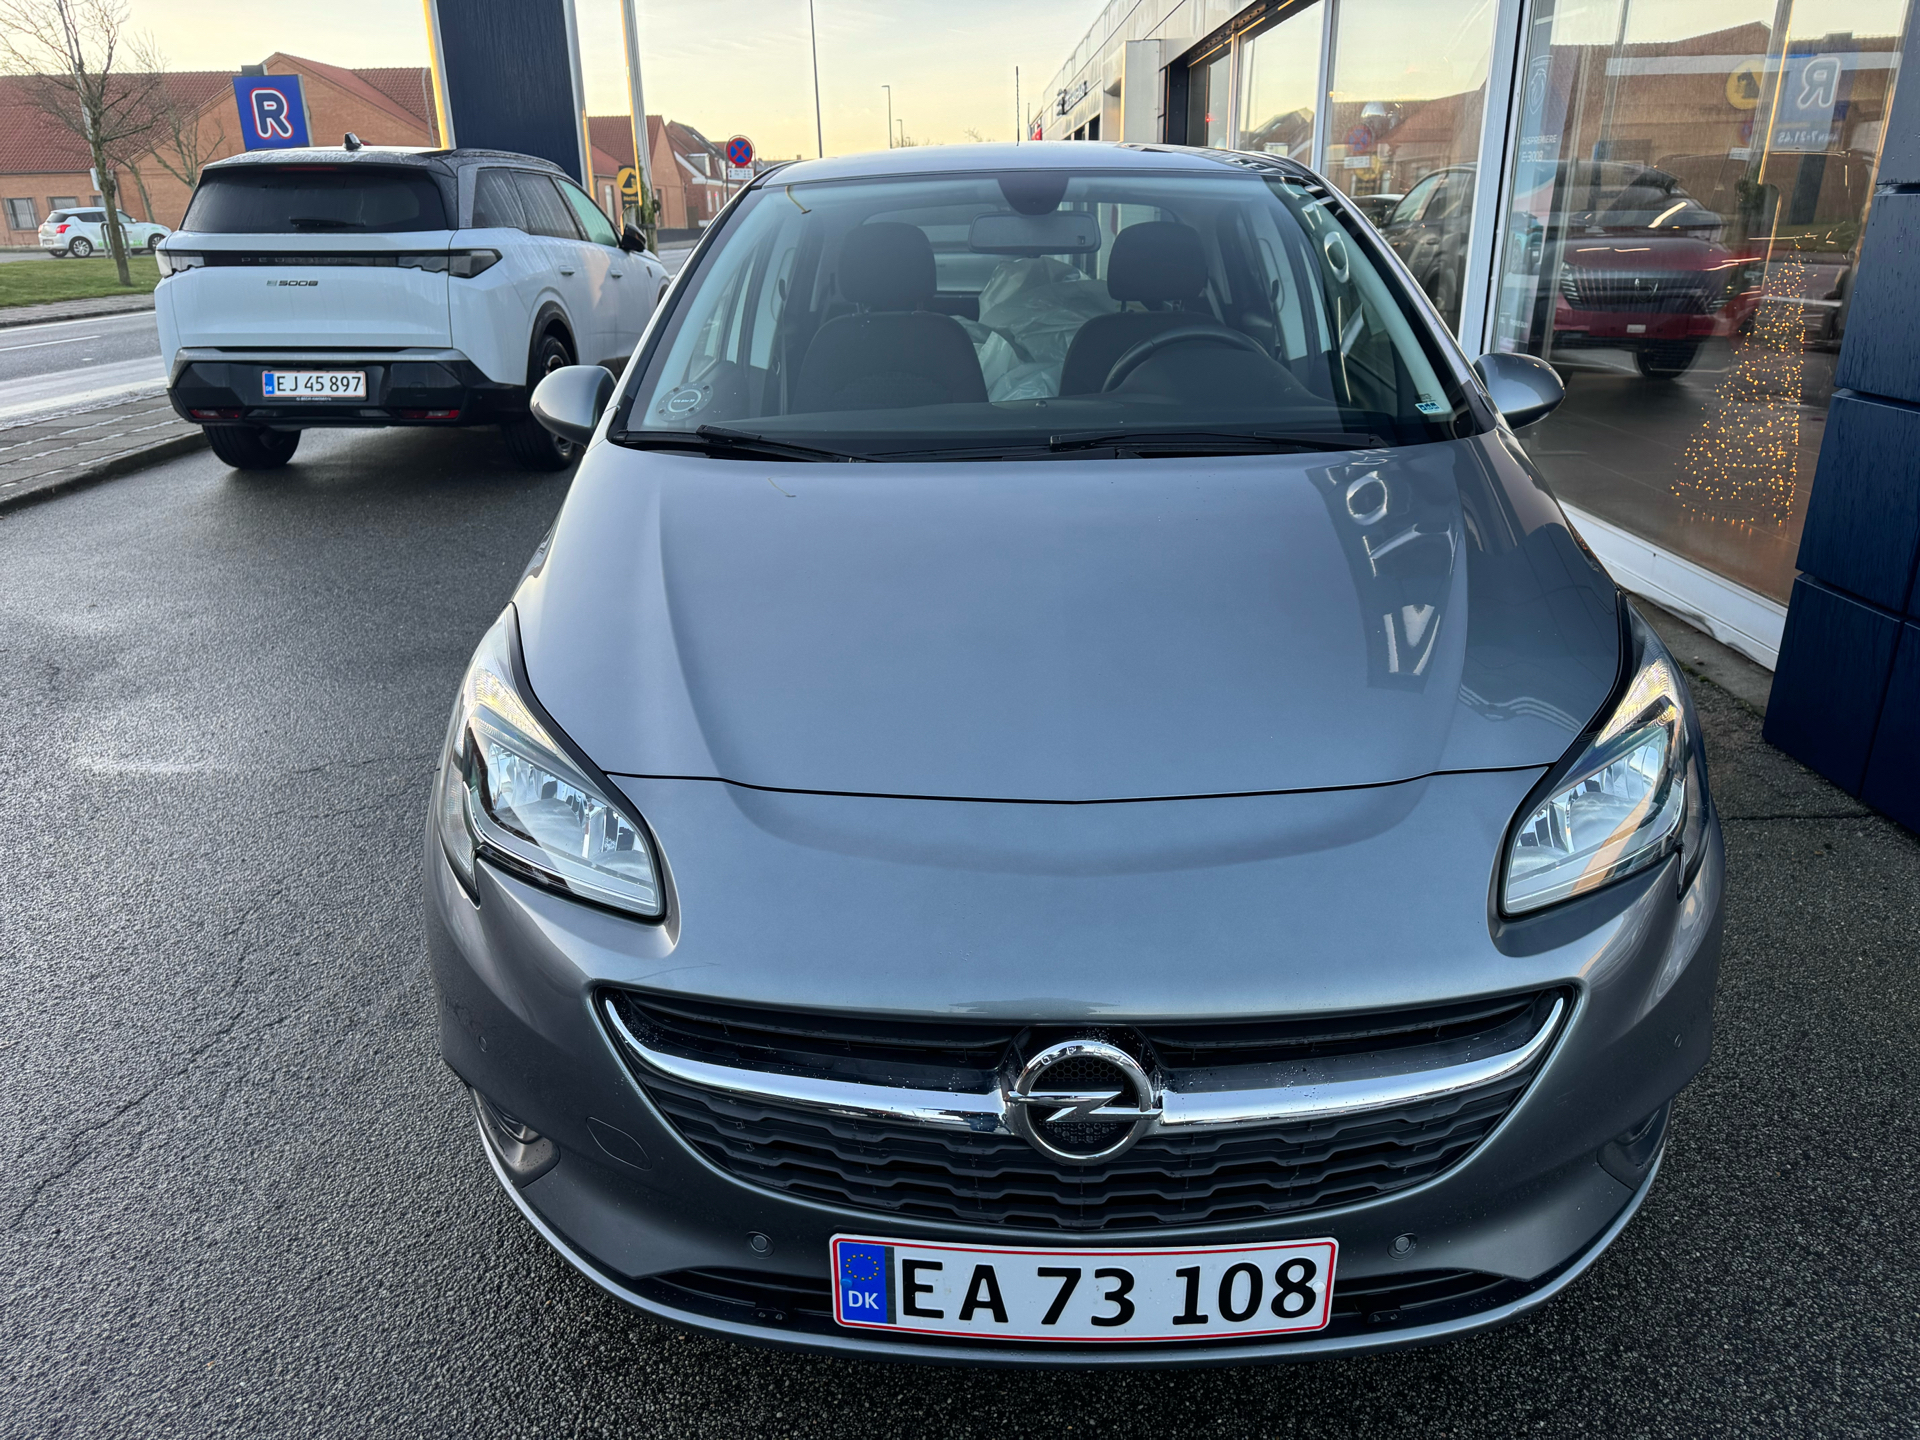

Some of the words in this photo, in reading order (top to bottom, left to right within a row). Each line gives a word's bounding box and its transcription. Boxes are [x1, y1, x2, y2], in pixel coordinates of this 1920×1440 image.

[249, 87, 294, 140] R
[276, 375, 298, 392] EJ
[304, 375, 325, 392] 45
[329, 375, 362, 392] 897
[848, 1290, 880, 1310] DK
[902, 1258, 1009, 1323] EA
[1037, 1266, 1136, 1327] 73
[1172, 1257, 1317, 1325] 108
